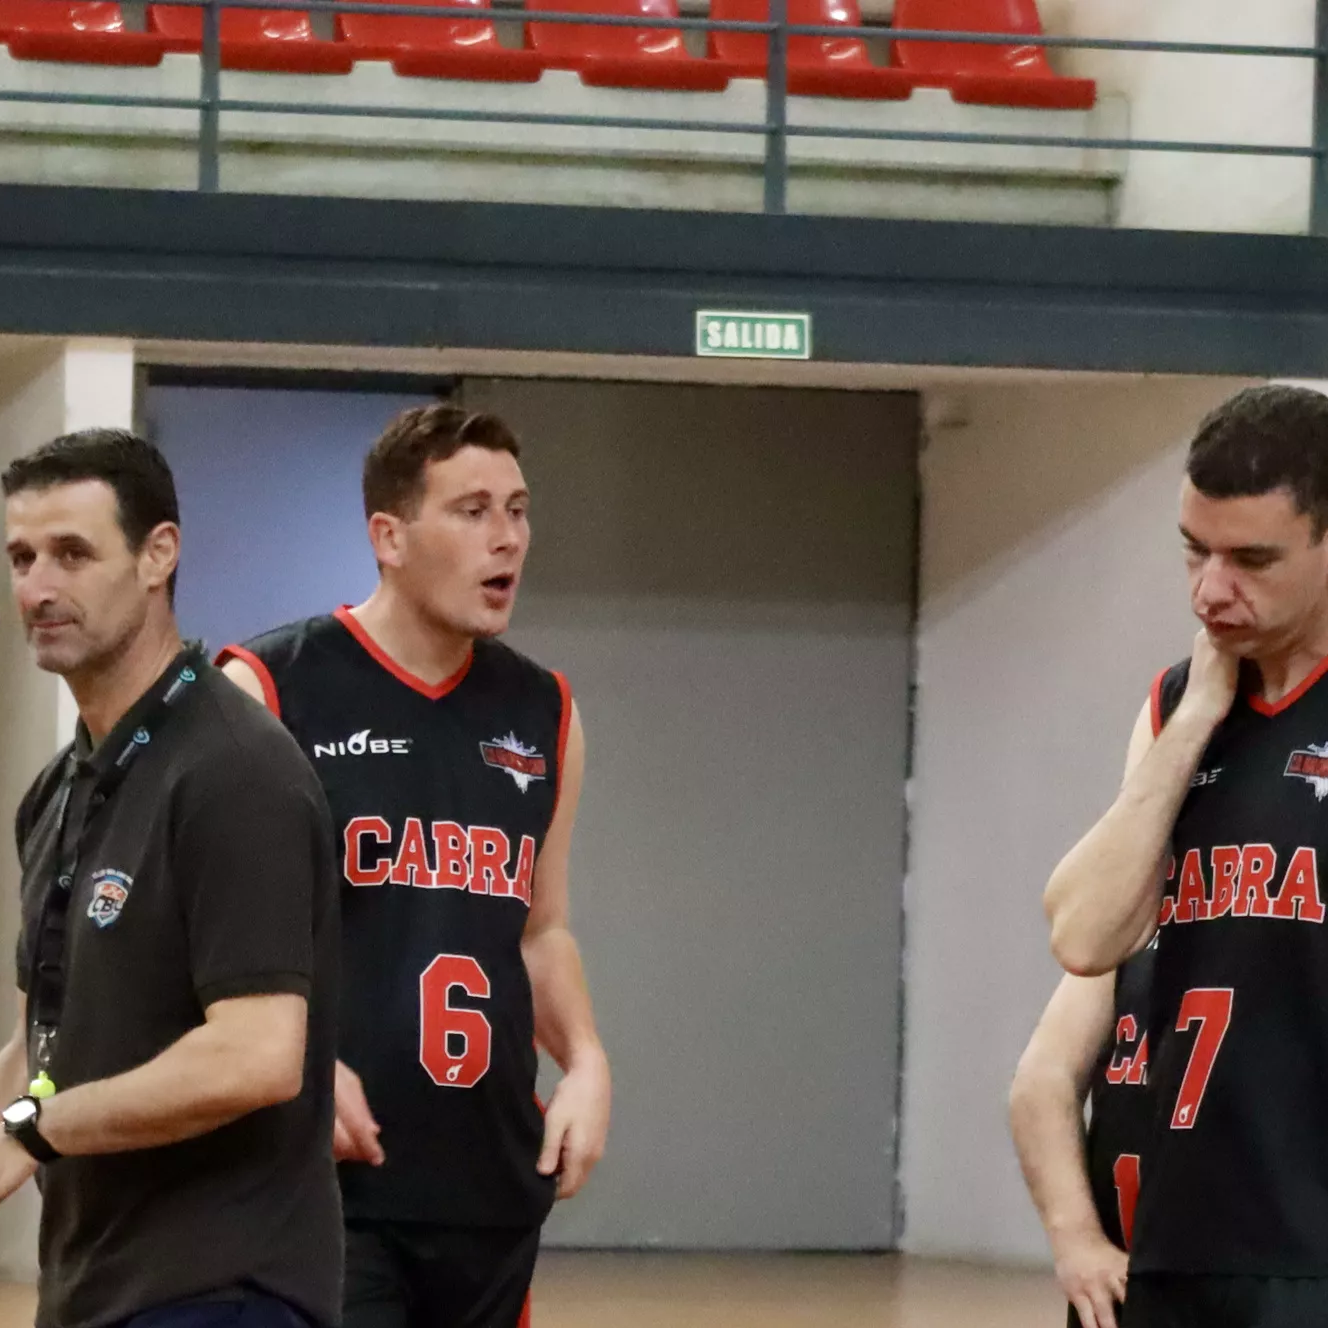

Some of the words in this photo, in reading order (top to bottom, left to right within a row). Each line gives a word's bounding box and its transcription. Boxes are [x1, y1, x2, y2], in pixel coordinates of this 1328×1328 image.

[706, 320, 800, 351] SALIDA
[313, 728, 410, 757] NIOBE
[343, 815, 537, 908] CABRA
[418, 953, 492, 1089] 6
[1168, 986, 1235, 1130] 7
